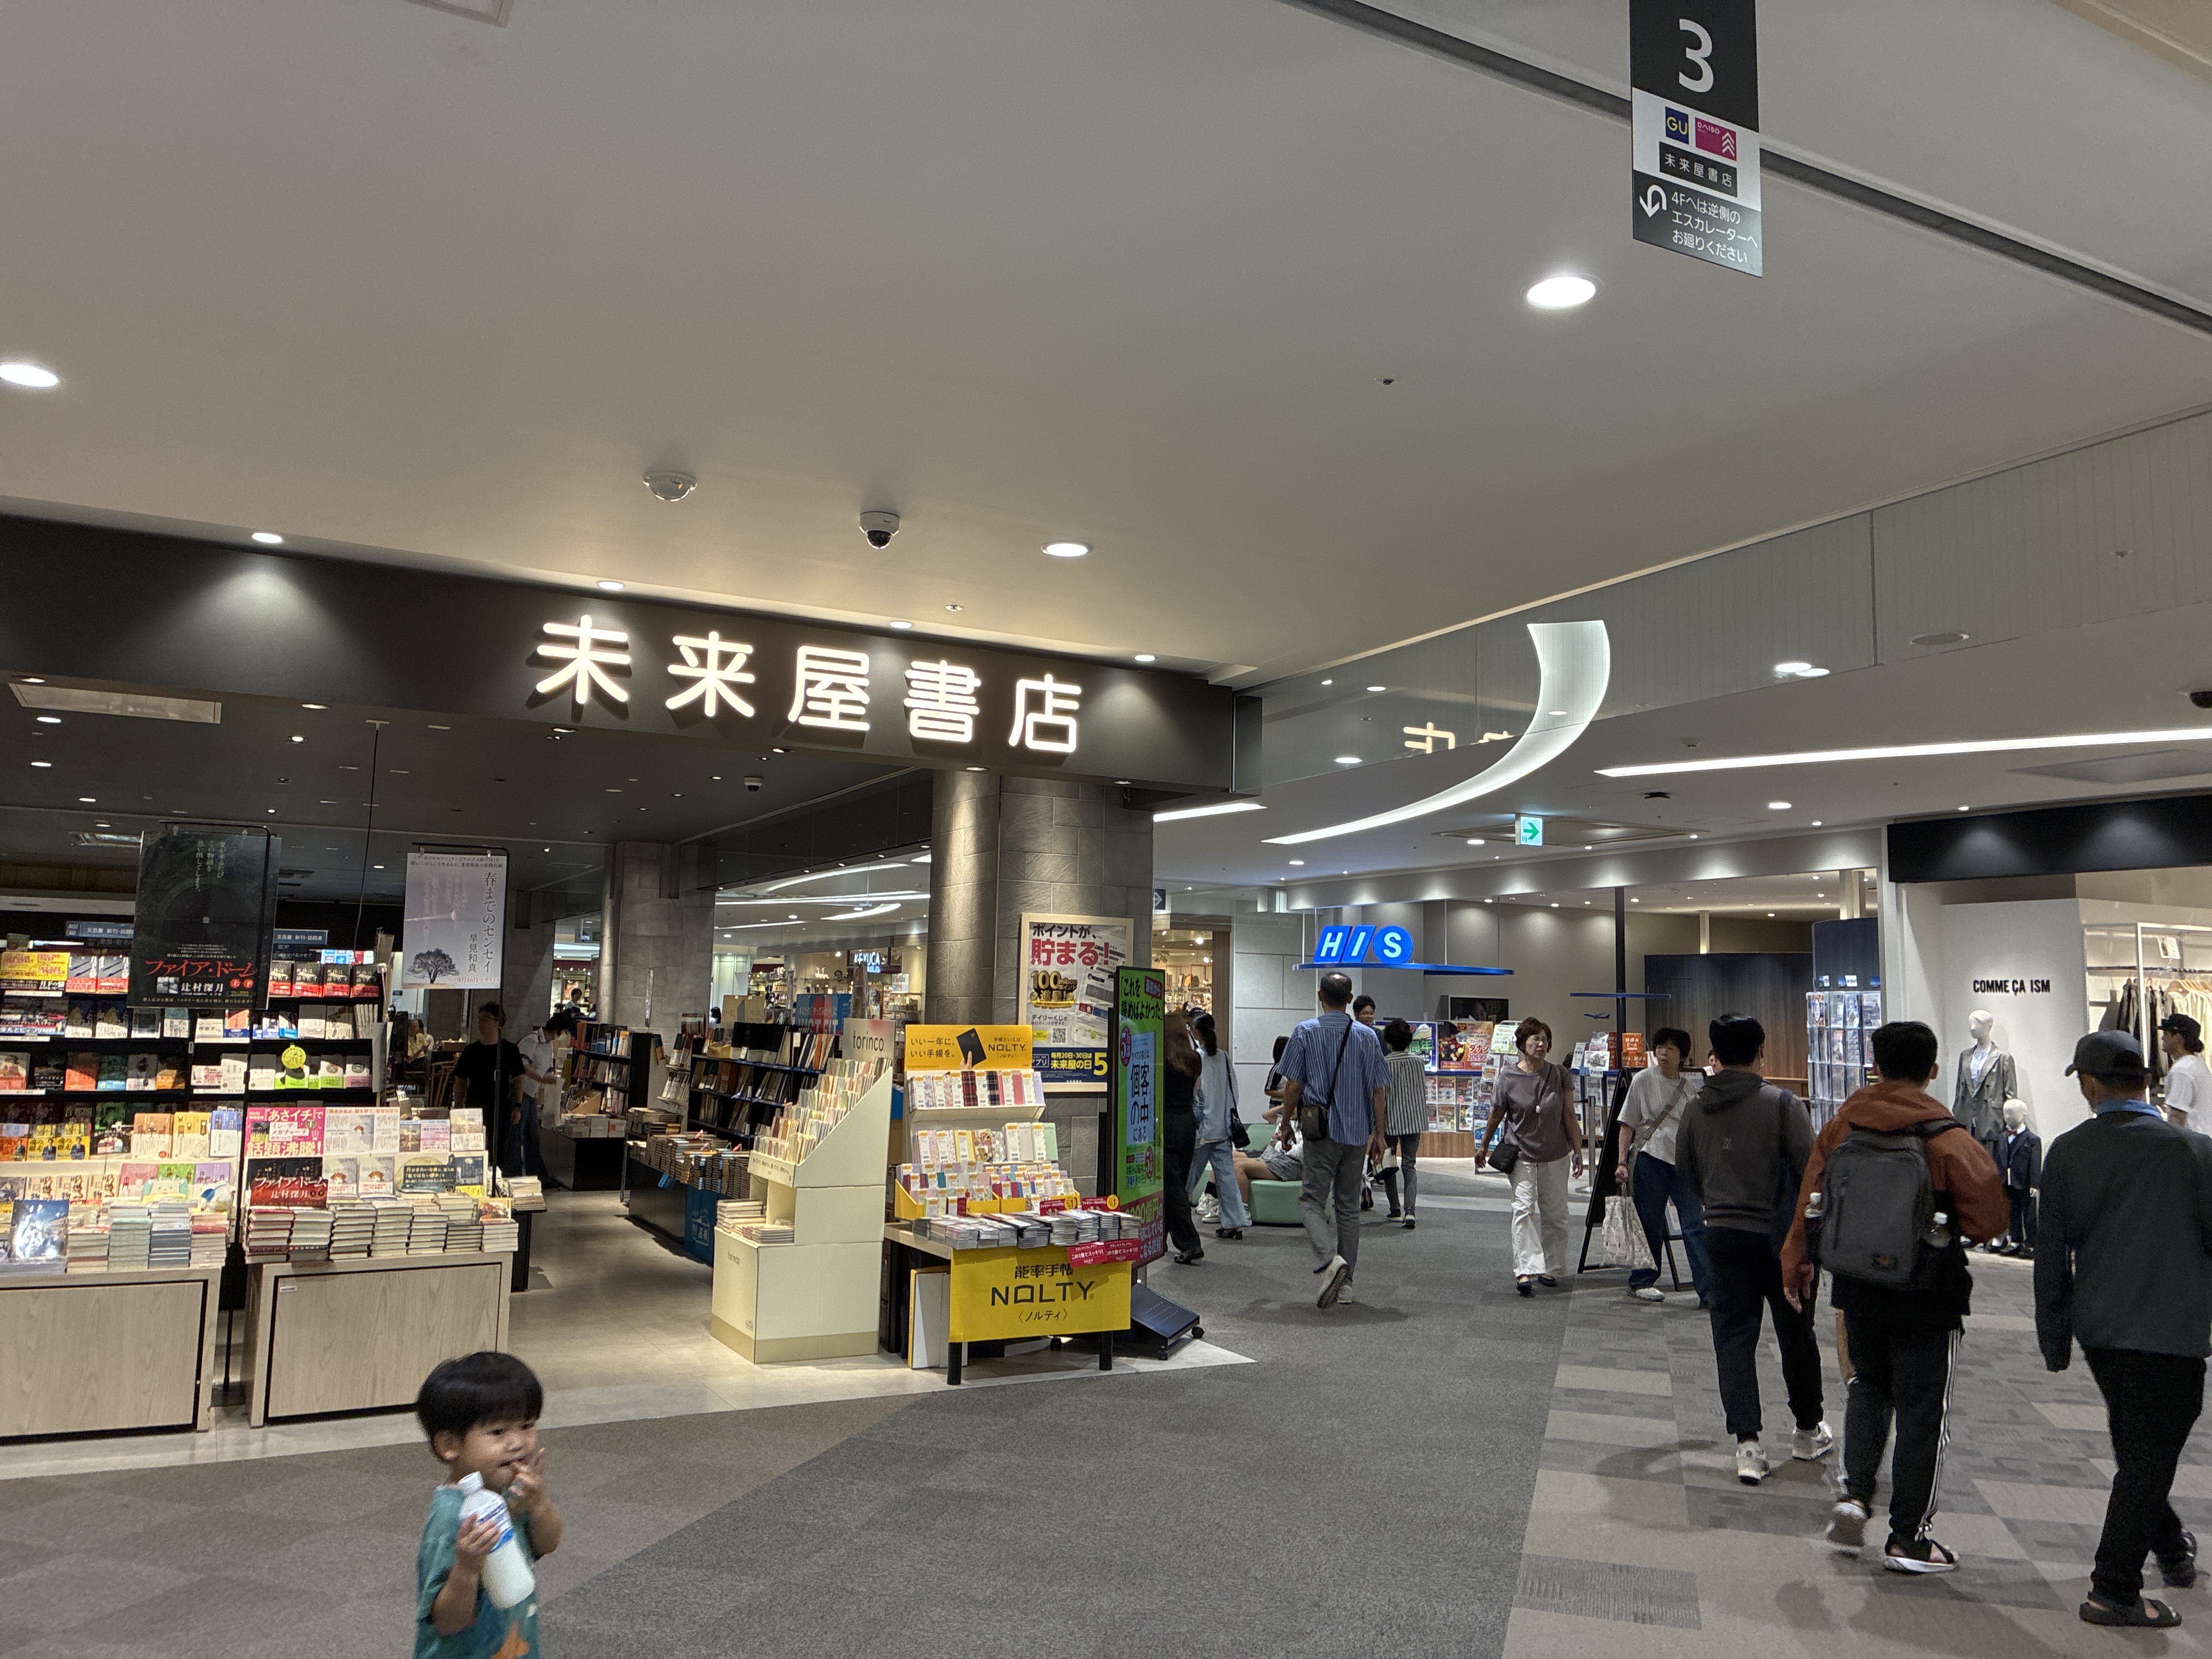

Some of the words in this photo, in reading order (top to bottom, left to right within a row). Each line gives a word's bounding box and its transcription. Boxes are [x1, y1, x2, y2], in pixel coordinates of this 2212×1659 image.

[1679, 19, 1714, 93] 3
[1667, 116, 1688, 136] GU
[1697, 122, 1720, 134] DAISO
[1664, 153, 1733, 188] 未来屋書店
[1671, 191, 1740, 225] 4Fへは逆側の
[1672, 212, 1758, 248] エスカレーターへ
[1673, 229, 1748, 263] お廻りください
[535, 614, 1082, 753] 未来屋書店
[482, 872, 497, 973] 春までのセンセイ
[1032, 924, 1097, 939] ポイントが、
[467, 934, 478, 973] 早見和真
[1030, 938, 1110, 966] 貯まる!
[1320, 932, 1402, 958] HIS
[145, 960, 256, 978] ファイア・ドーム
[180, 983, 224, 992] 辻村深月
[1030, 970, 1062, 990] 100
[1973, 979, 2010, 993] COMME
[2012, 979, 2026, 997] ÇA
[2030, 979, 2051, 993] ISM
[1040, 990, 1066, 1002] 進呈!
[853, 1030, 885, 1052] torinco
[911, 1037, 955, 1046] いい一年に、
[988, 1043, 1026, 1052] NOLTY
[910, 1049, 955, 1058] いい手帳を。
[1051, 1060, 1092, 1070] 未来屋の日
[1093, 1052, 1108, 1076] 5
[246, 1141, 322, 1157] 話題沸騰!
[253, 1176, 327, 1189] ファイア・ドーム
[1014, 1263, 1074, 1279] 能率手帳
[991, 1280, 1095, 1307] NOLTY
